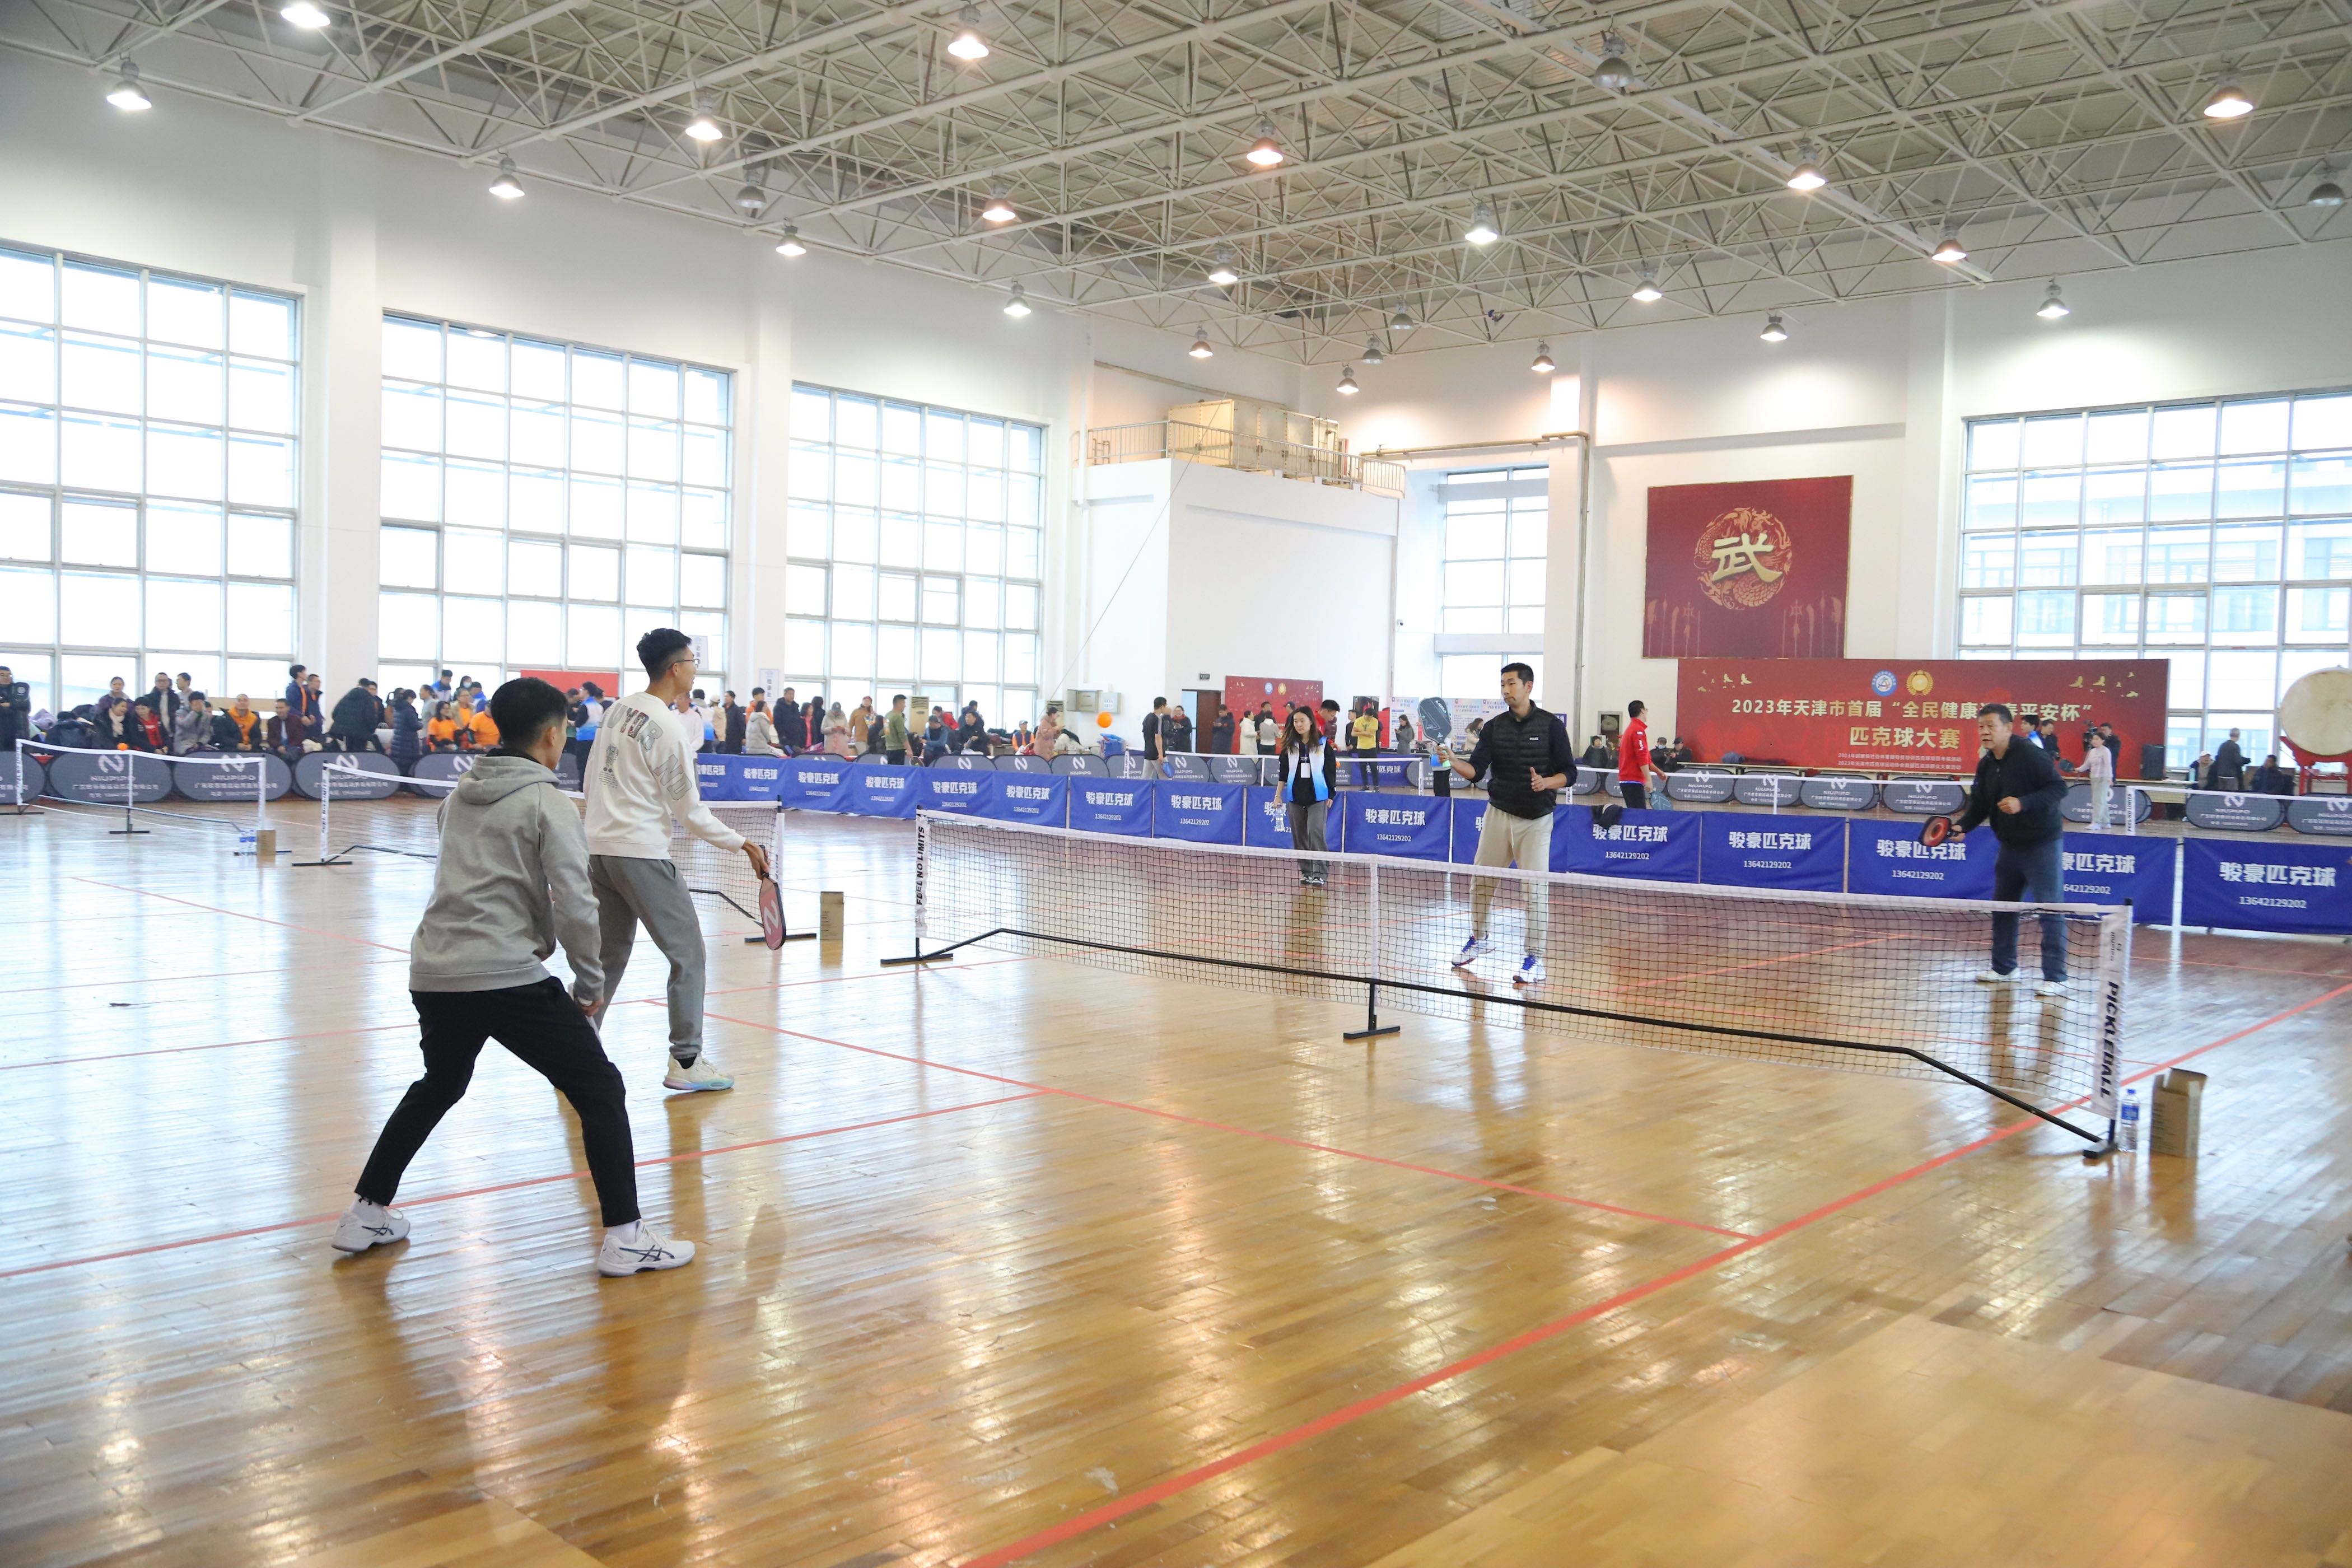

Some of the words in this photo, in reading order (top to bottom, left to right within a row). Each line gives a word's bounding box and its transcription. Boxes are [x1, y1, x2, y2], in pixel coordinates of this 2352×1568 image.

[1711, 533, 1783, 582] 武
[1850, 726, 1960, 749] 匹克球大赛
[744, 768, 778, 780] 骏豪匹克球
[1366, 765, 1401, 773] 骏匹克球
[798, 772, 839, 785] 骏豪匹克球
[865, 776, 905, 789] 骏豪匹克球
[932, 782, 977, 794] 骏豪匹克球
[1006, 786, 1050, 800] 骏豪匹克球
[1086, 792, 1133, 806] 骏豪匹克球
[1171, 795, 1222, 811] 骏豪匹克球
[1365, 809, 1426, 826] 骏豪匹克球
[1593, 824, 1668, 842] 骏豪匹克球
[1729, 832, 1812, 850] 骏豪匹克球
[1605, 852, 1650, 860] 13642129202
[1877, 839, 1967, 861] 骏豪匹克球
[1743, 860, 1792, 869] 13642129202
[2061, 852, 2135, 874] 豪匹克球
[916, 864, 923, 878] NO
[1892, 870, 1944, 880] 13642129202
[2219, 861, 2336, 887] 骏豪匹克球
[2063, 884, 2111, 894] 642129202
[2239, 896, 2307, 909] 13642129202
